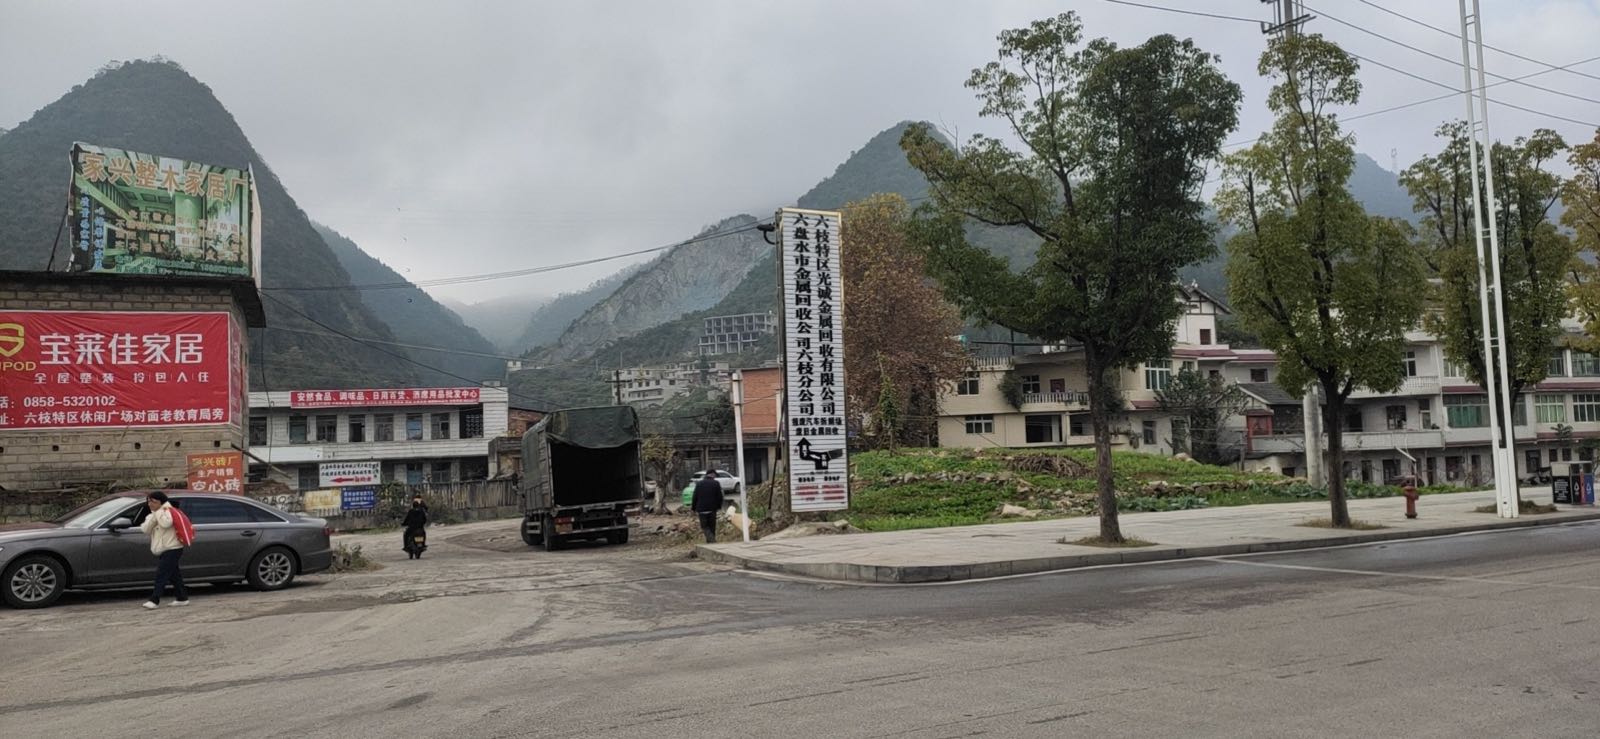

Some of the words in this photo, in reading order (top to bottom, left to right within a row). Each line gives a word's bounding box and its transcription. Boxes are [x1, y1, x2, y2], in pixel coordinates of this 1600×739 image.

[82, 152, 248, 201] 家兴整木家居厂
[793, 212, 815, 416] 六盘水市金属回收公司六枝分公司
[39, 333, 204, 365] 宝莱佳家居
[0, 361, 36, 372] POD
[197, 468, 234, 478] 生产销售
[191, 478, 241, 492] 空心砖
